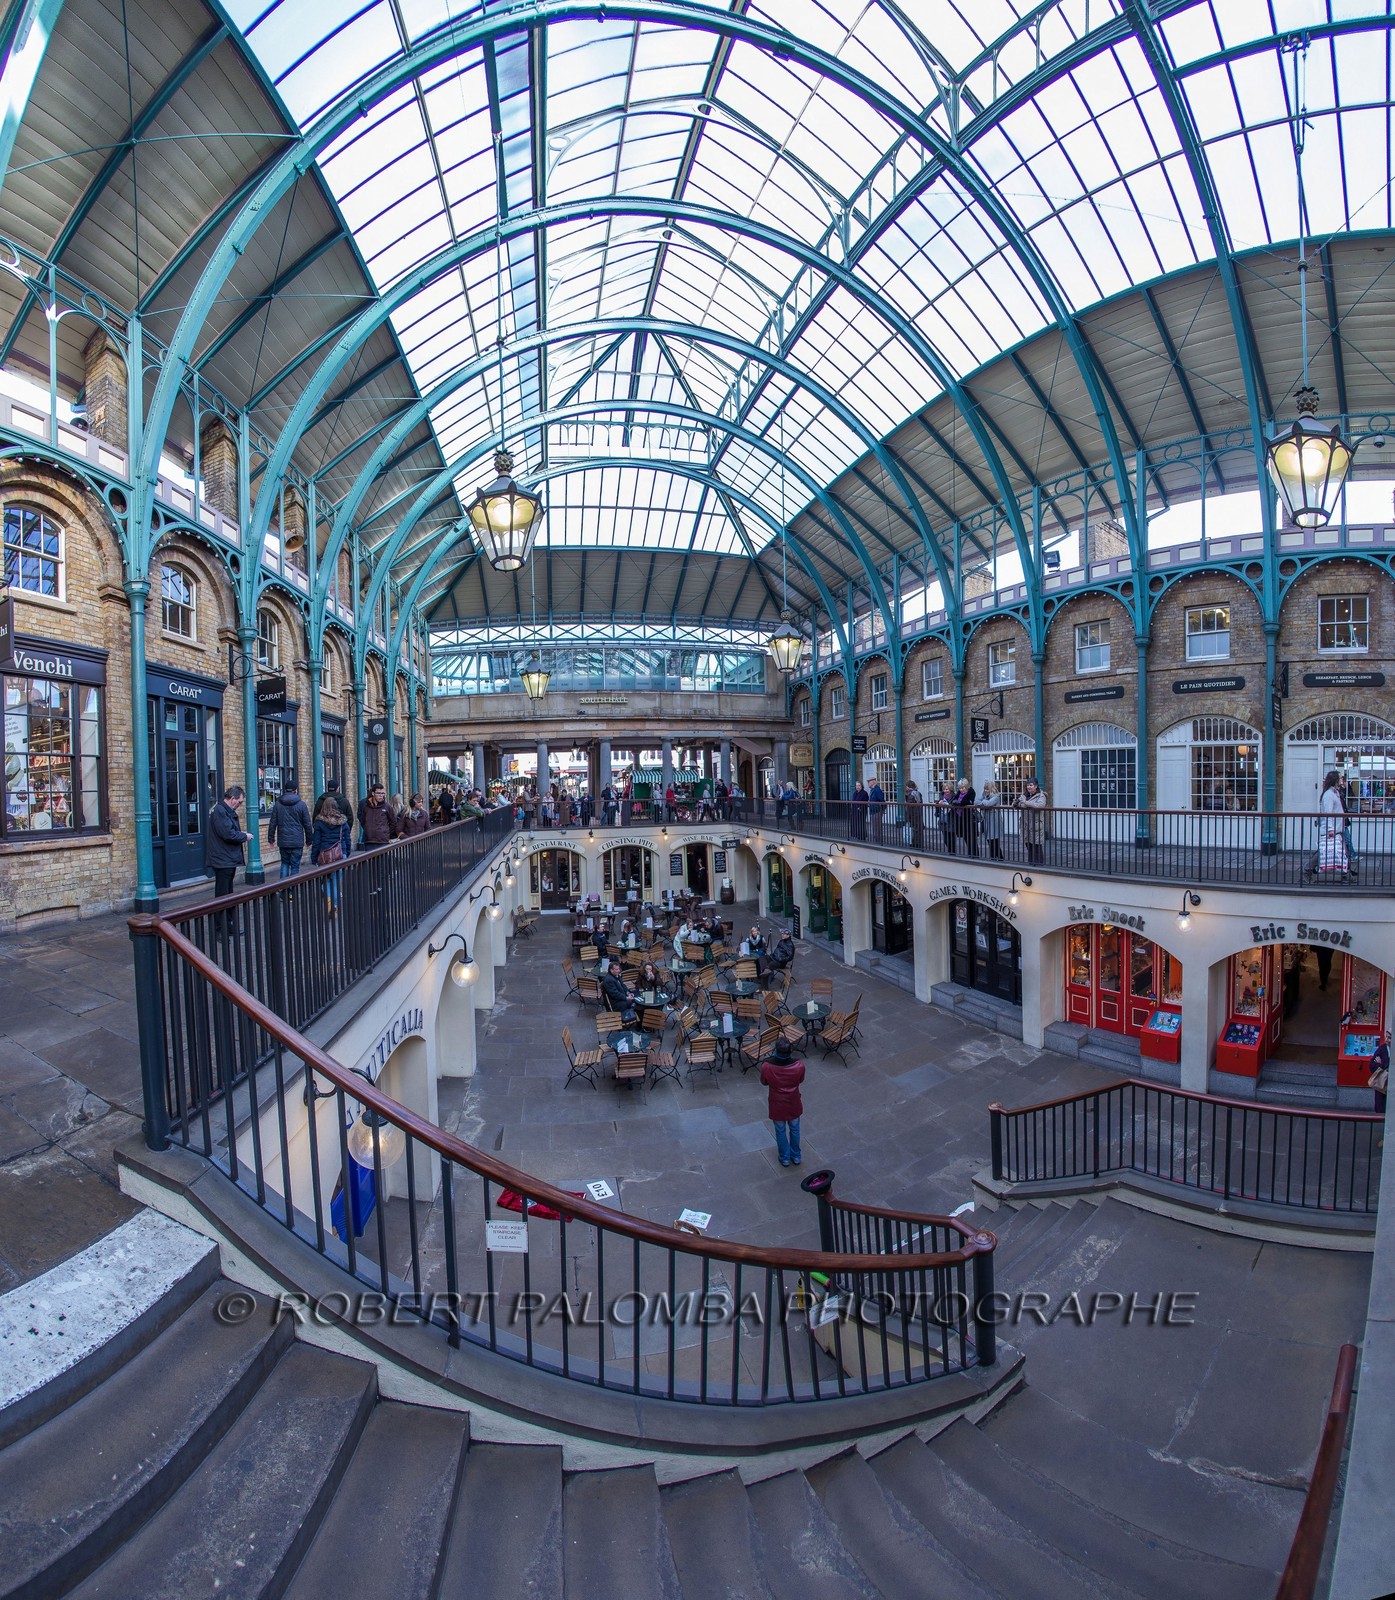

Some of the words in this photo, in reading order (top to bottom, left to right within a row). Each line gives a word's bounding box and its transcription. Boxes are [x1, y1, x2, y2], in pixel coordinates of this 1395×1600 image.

[13, 650, 73, 677] Venchi
[532, 841, 577, 851] RESTAURANT
[601, 837, 637, 850] CRUSTING
[638, 838, 655, 849] PIPE
[851, 867, 871, 881] GAMES
[872, 868, 909, 895] WORKSHOP
[929, 885, 958, 901] GAMES
[961, 885, 1017, 921] WORKSHOP
[1067, 904, 1094, 921] Eric
[1101, 905, 1146, 932] Snook
[1250, 922, 1286, 943] Eric
[1297, 922, 1352, 949] Snook
